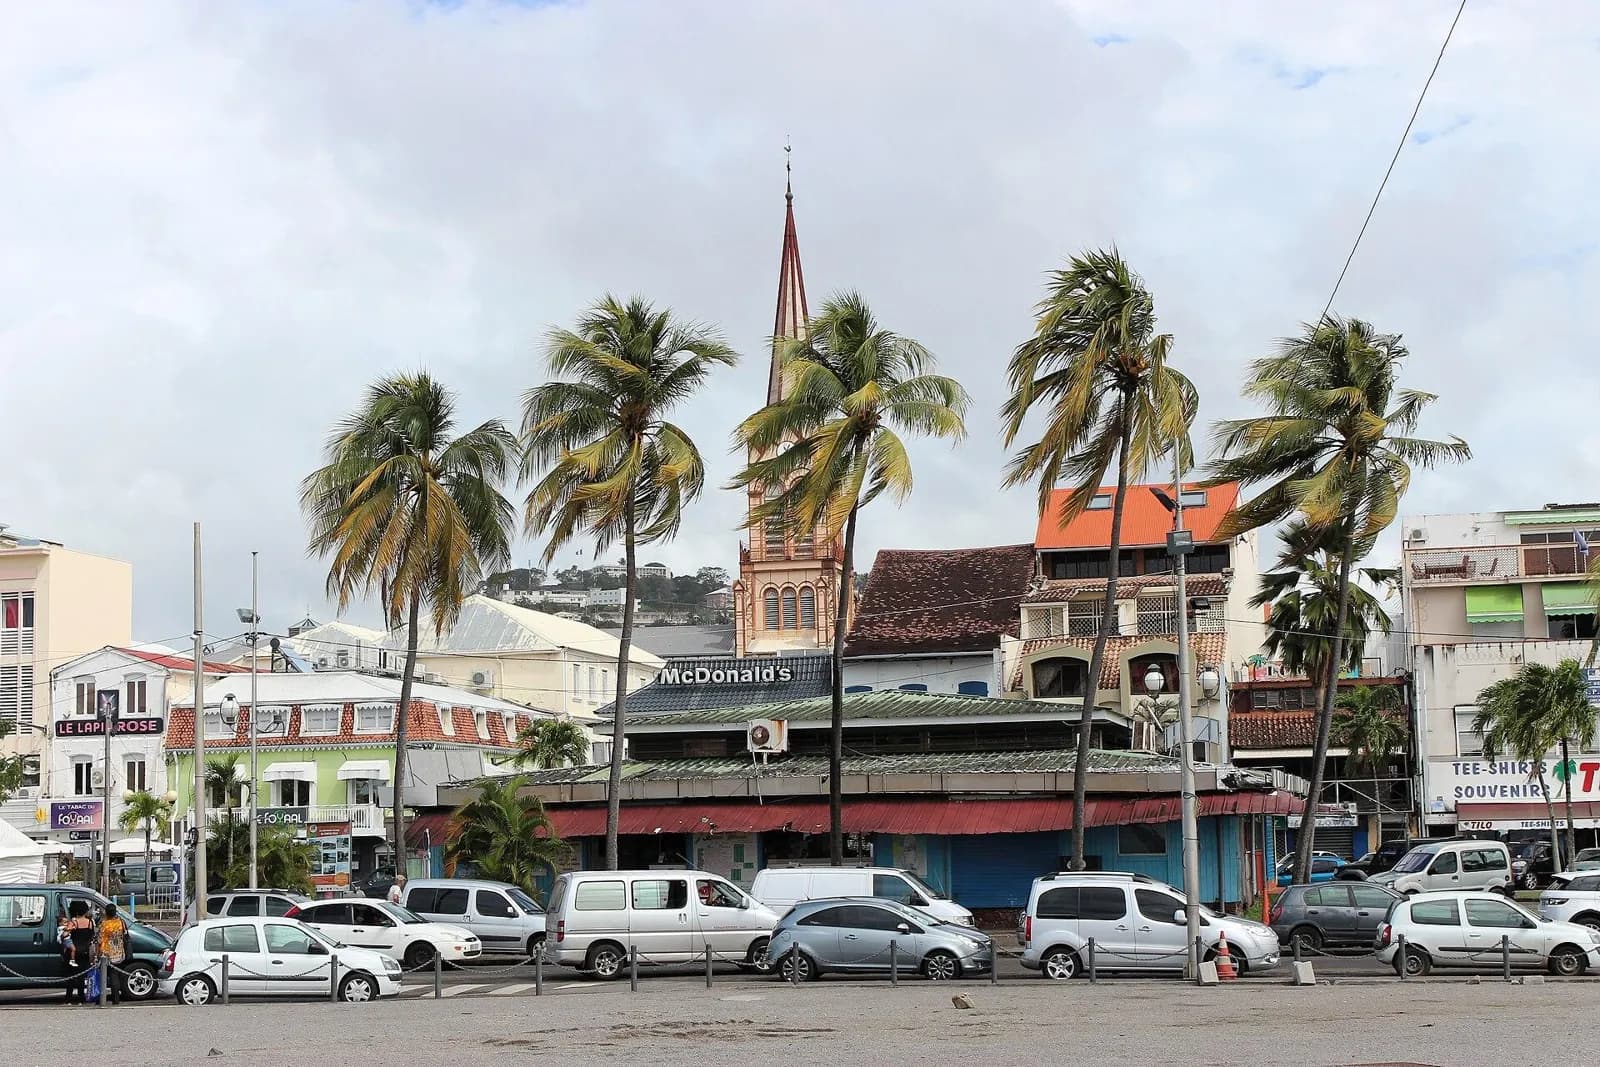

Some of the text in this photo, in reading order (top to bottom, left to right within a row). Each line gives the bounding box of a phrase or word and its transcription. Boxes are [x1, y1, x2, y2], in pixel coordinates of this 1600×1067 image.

[660, 666, 792, 685] McDonald's
[59, 720, 157, 734] LE LAPI ROSE
[1579, 762, 1600, 793] T
[1471, 821, 1492, 830] TILO
[1521, 820, 1565, 828] TEE-SHITS
